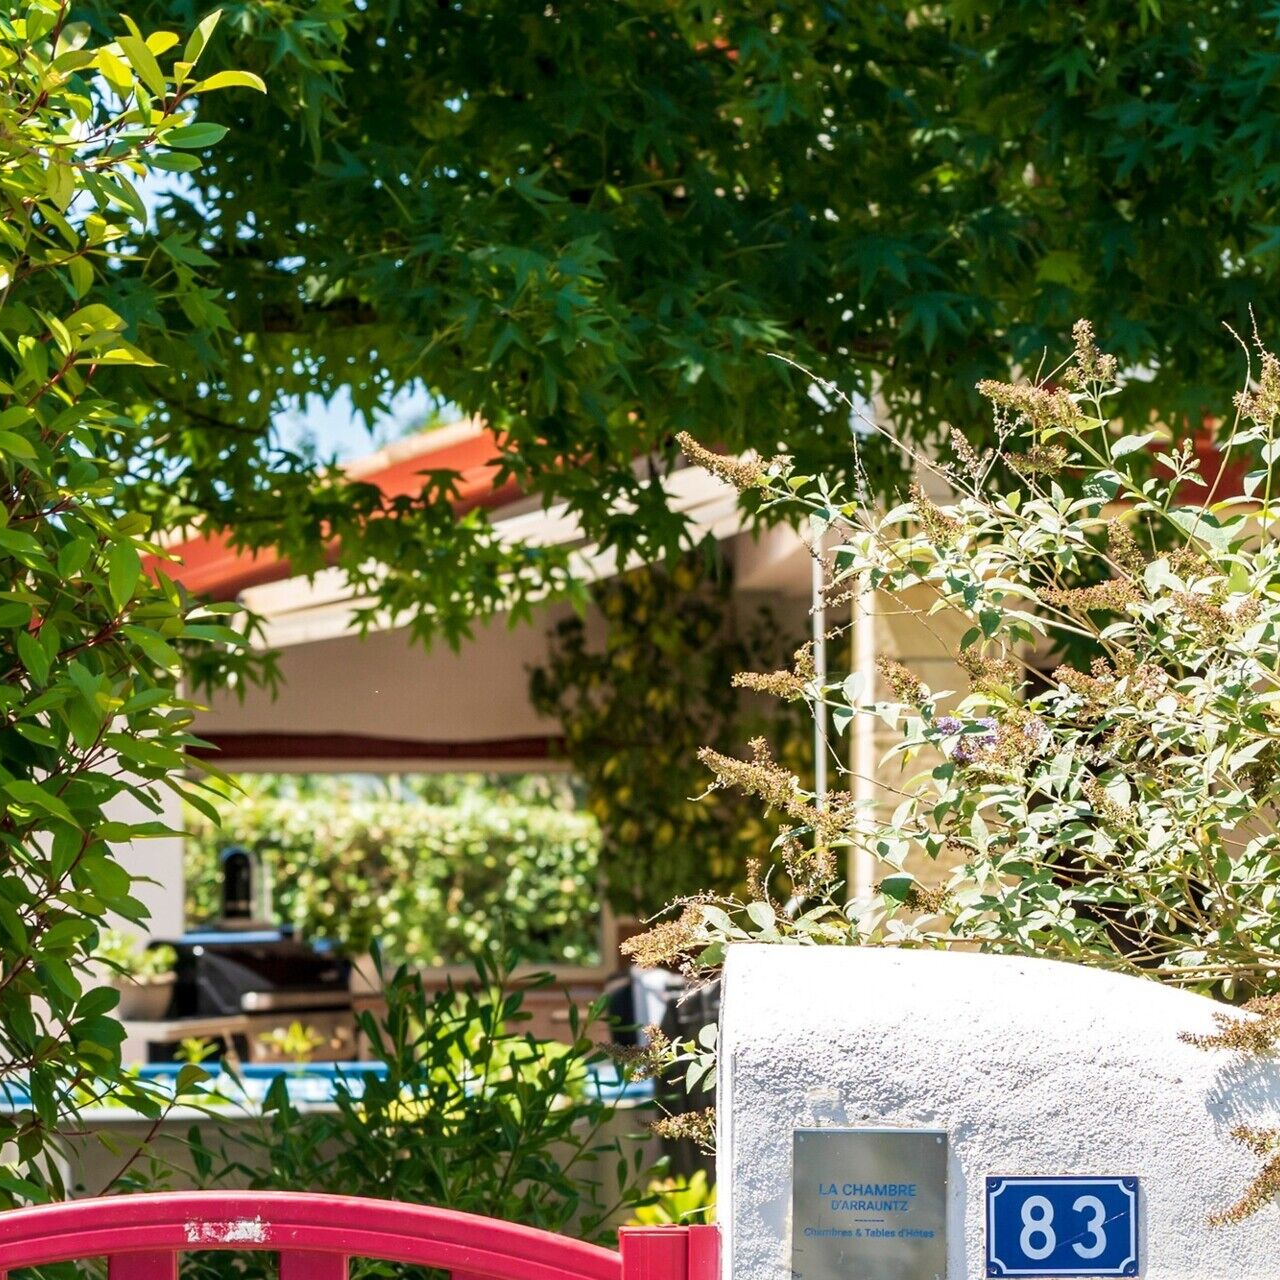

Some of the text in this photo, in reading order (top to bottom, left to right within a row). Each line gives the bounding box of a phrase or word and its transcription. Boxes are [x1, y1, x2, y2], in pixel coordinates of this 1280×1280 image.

[818, 1183, 917, 1197] LA CHAMBRE
[864, 1227, 895, 1238] Tables
[1018, 1194, 1108, 1261] 83
